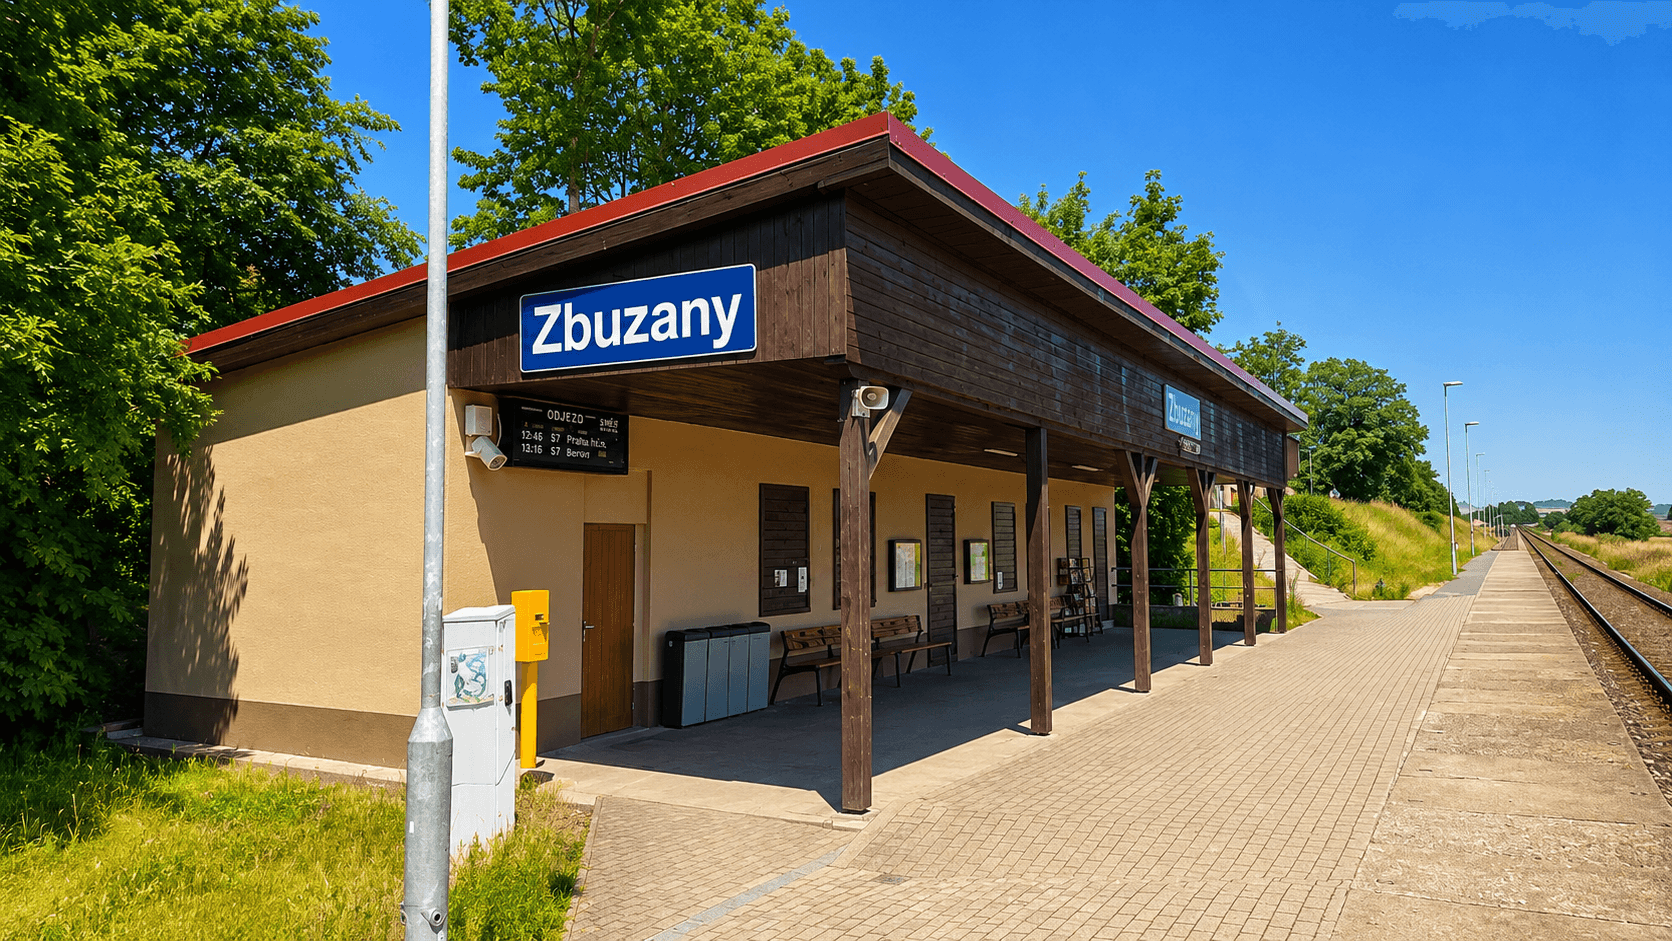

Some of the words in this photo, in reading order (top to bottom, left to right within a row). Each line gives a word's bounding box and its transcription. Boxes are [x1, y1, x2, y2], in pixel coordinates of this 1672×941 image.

[532, 293, 742, 355] Zbuzany
[521, 430, 544, 442] 12:46
[550, 433, 561, 443] S7
[521, 443, 543, 455] 13:16
[550, 446, 561, 456] S7
